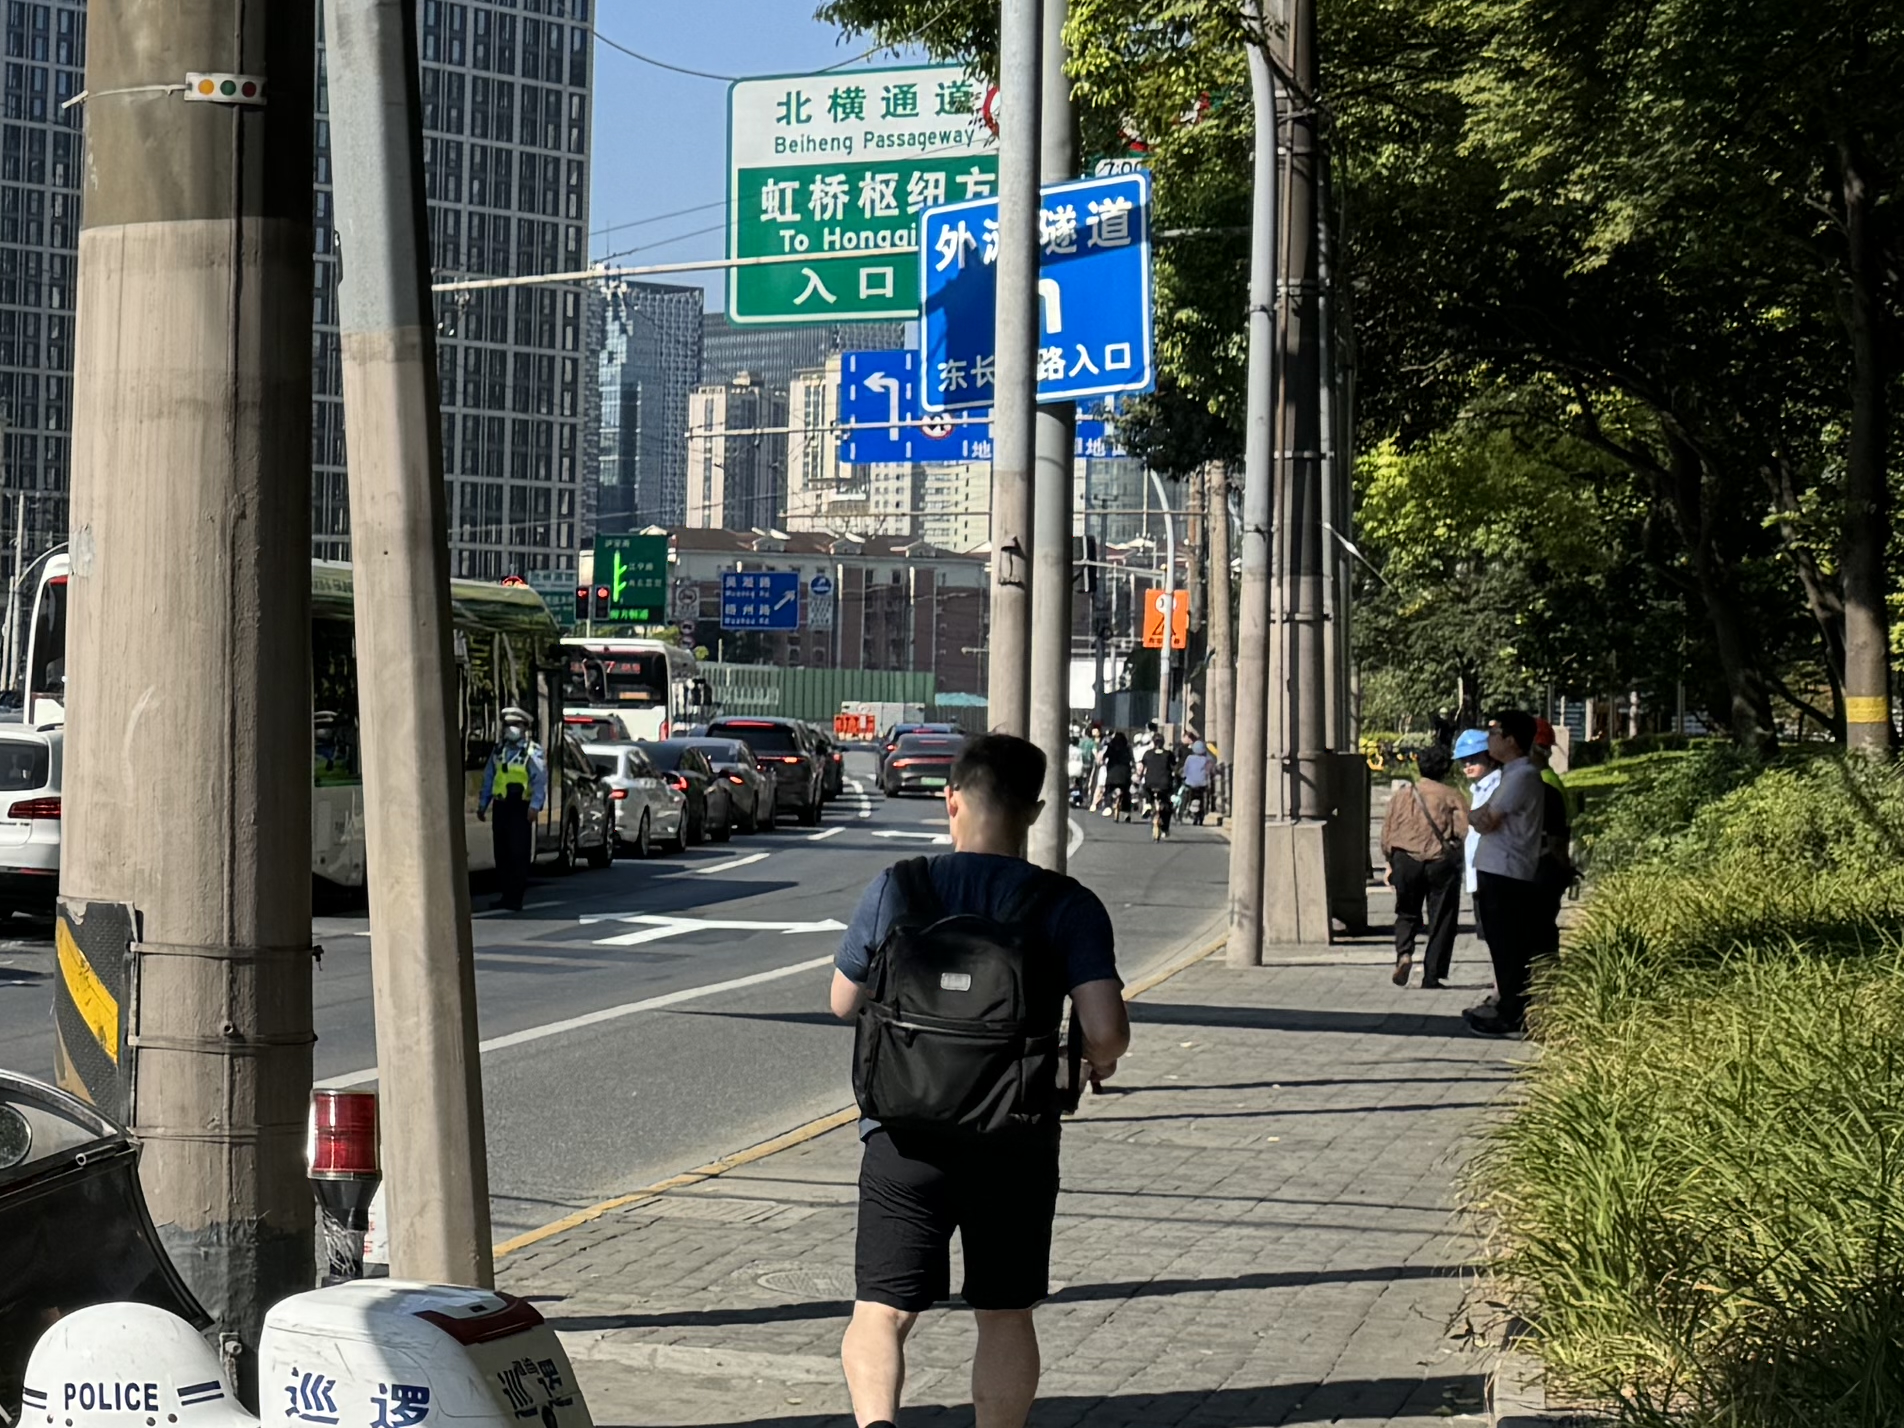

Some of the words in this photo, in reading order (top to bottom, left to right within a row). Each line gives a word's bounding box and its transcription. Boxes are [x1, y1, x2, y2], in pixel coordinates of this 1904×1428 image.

[776, 80, 976, 126] 北横通道
[774, 132, 852, 155] Beiheng
[863, 128, 975, 152] Passageway
[779, 230, 809, 253] To
[793, 266, 895, 306] 入口
[938, 342, 1131, 392] 东长路入口
[64, 1382, 159, 1412] POLICE
